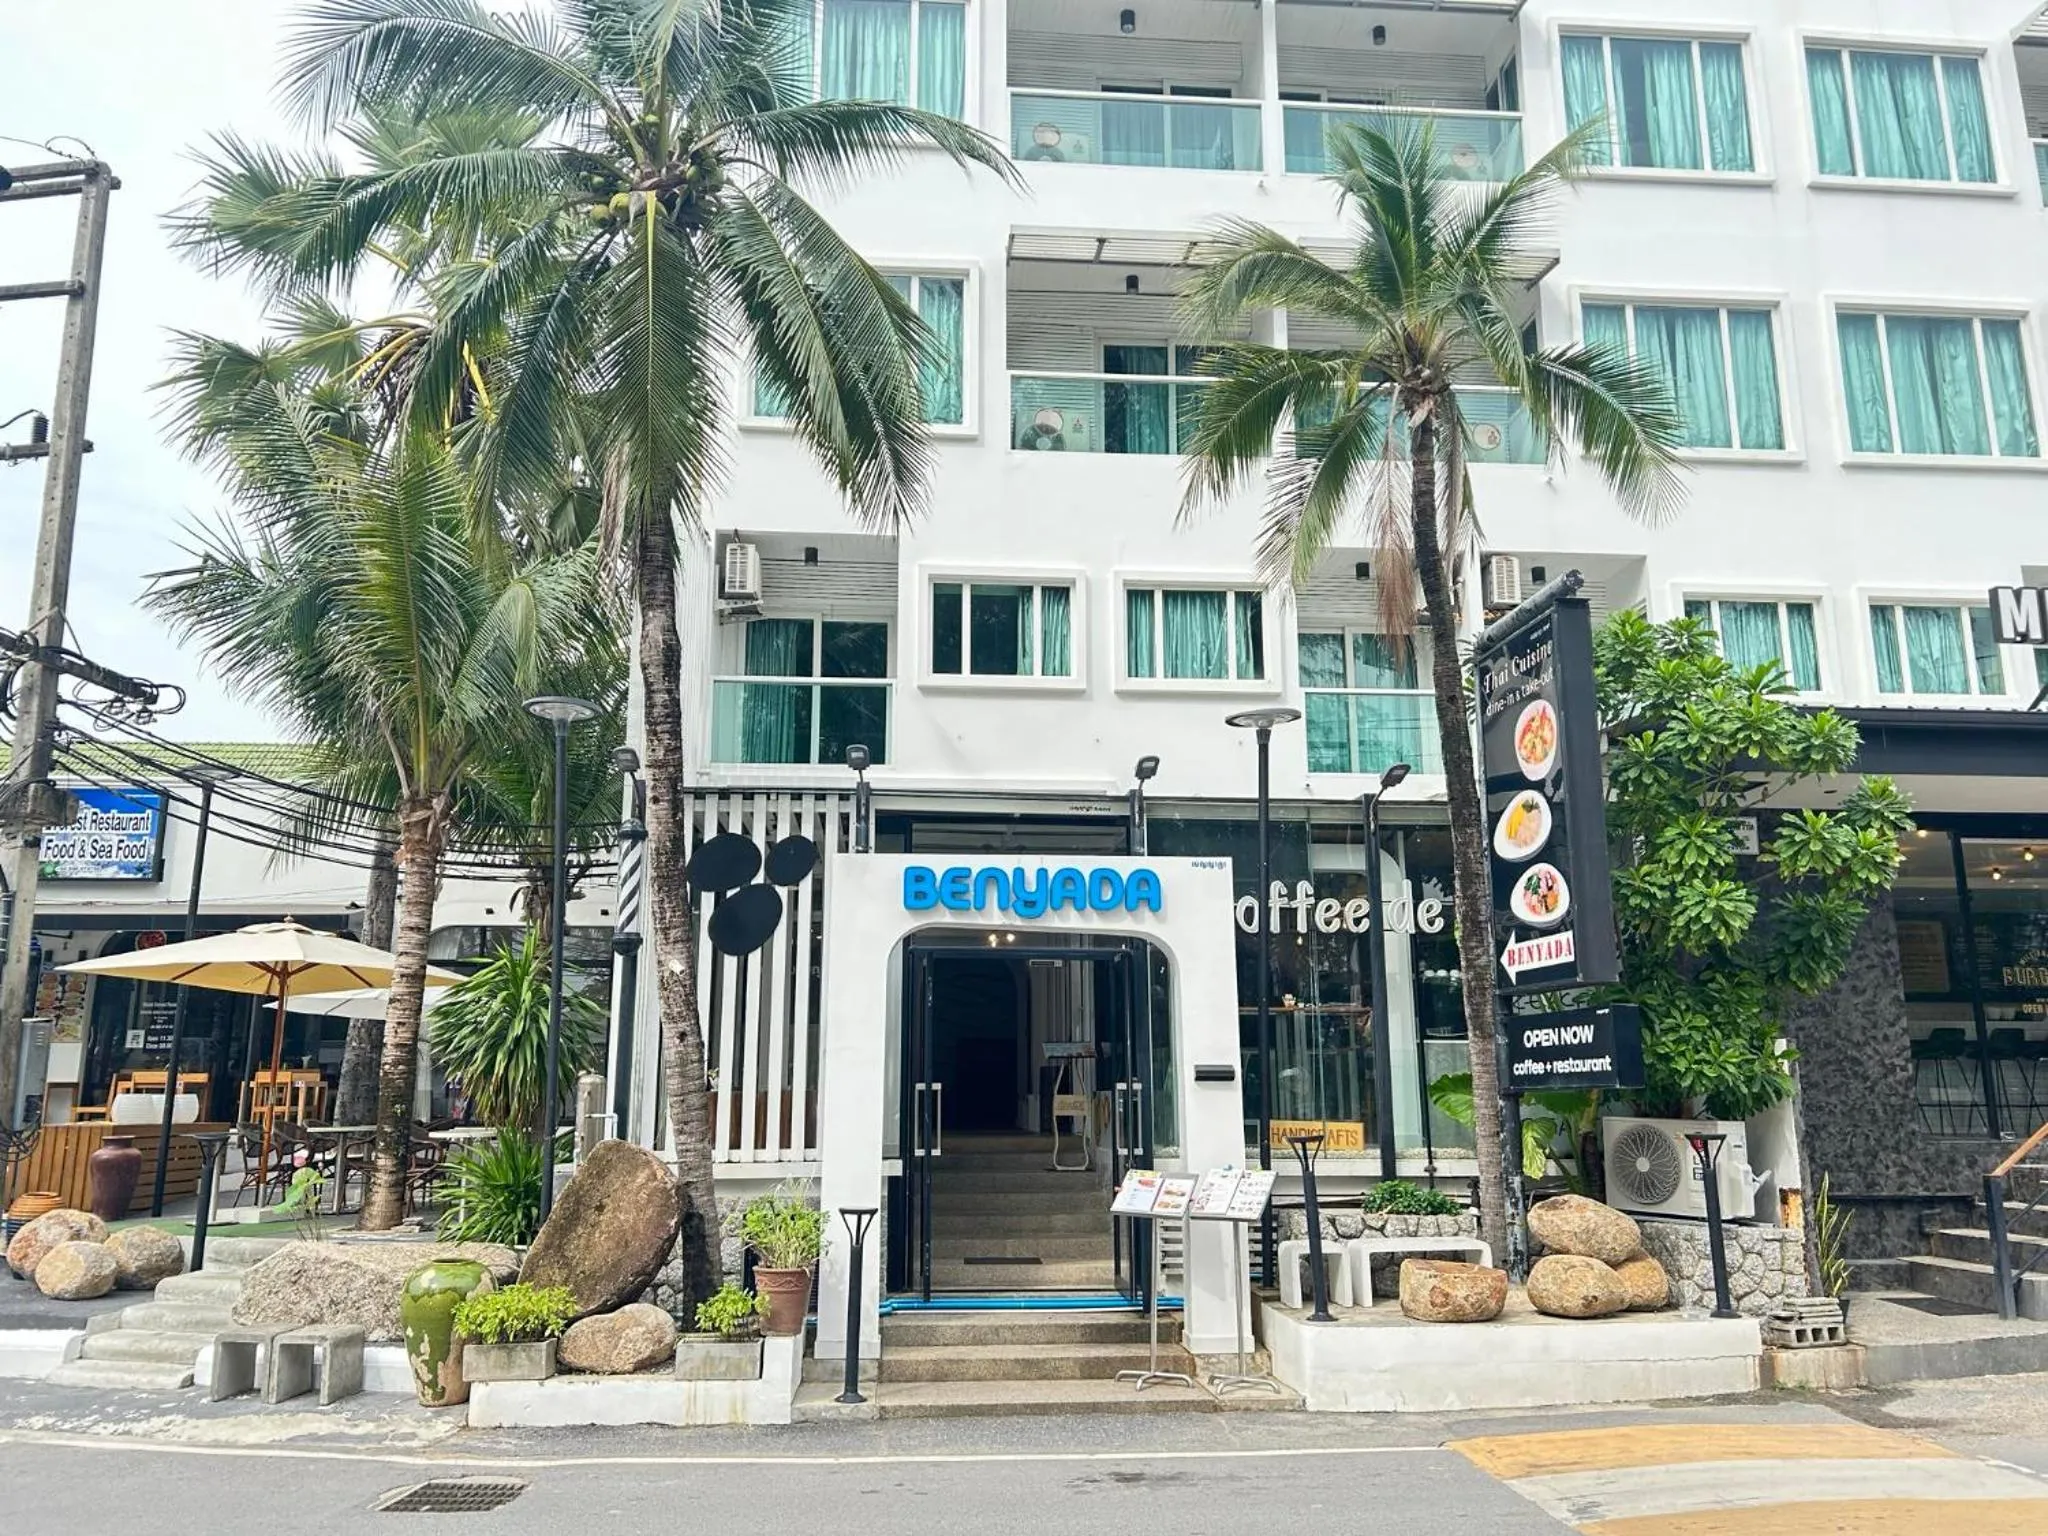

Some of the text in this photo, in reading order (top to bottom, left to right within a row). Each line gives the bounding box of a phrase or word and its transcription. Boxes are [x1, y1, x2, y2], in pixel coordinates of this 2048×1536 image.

[1483, 640, 1553, 694] Thai Cuisine
[1486, 693, 1515, 717] dine-in
[1521, 666, 1553, 698] take-out
[89, 811, 151, 831] Restaurant
[44, 839, 147, 859] Food & Sea Food
[904, 866, 1161, 919] BENYADA
[1236, 880, 1371, 934] offee
[1507, 936, 1573, 967] BENYADA
[1523, 1024, 1595, 1048] OPEN NOW
[1513, 1058, 1545, 1076] coffee
[1553, 1054, 1612, 1074] restaurant
